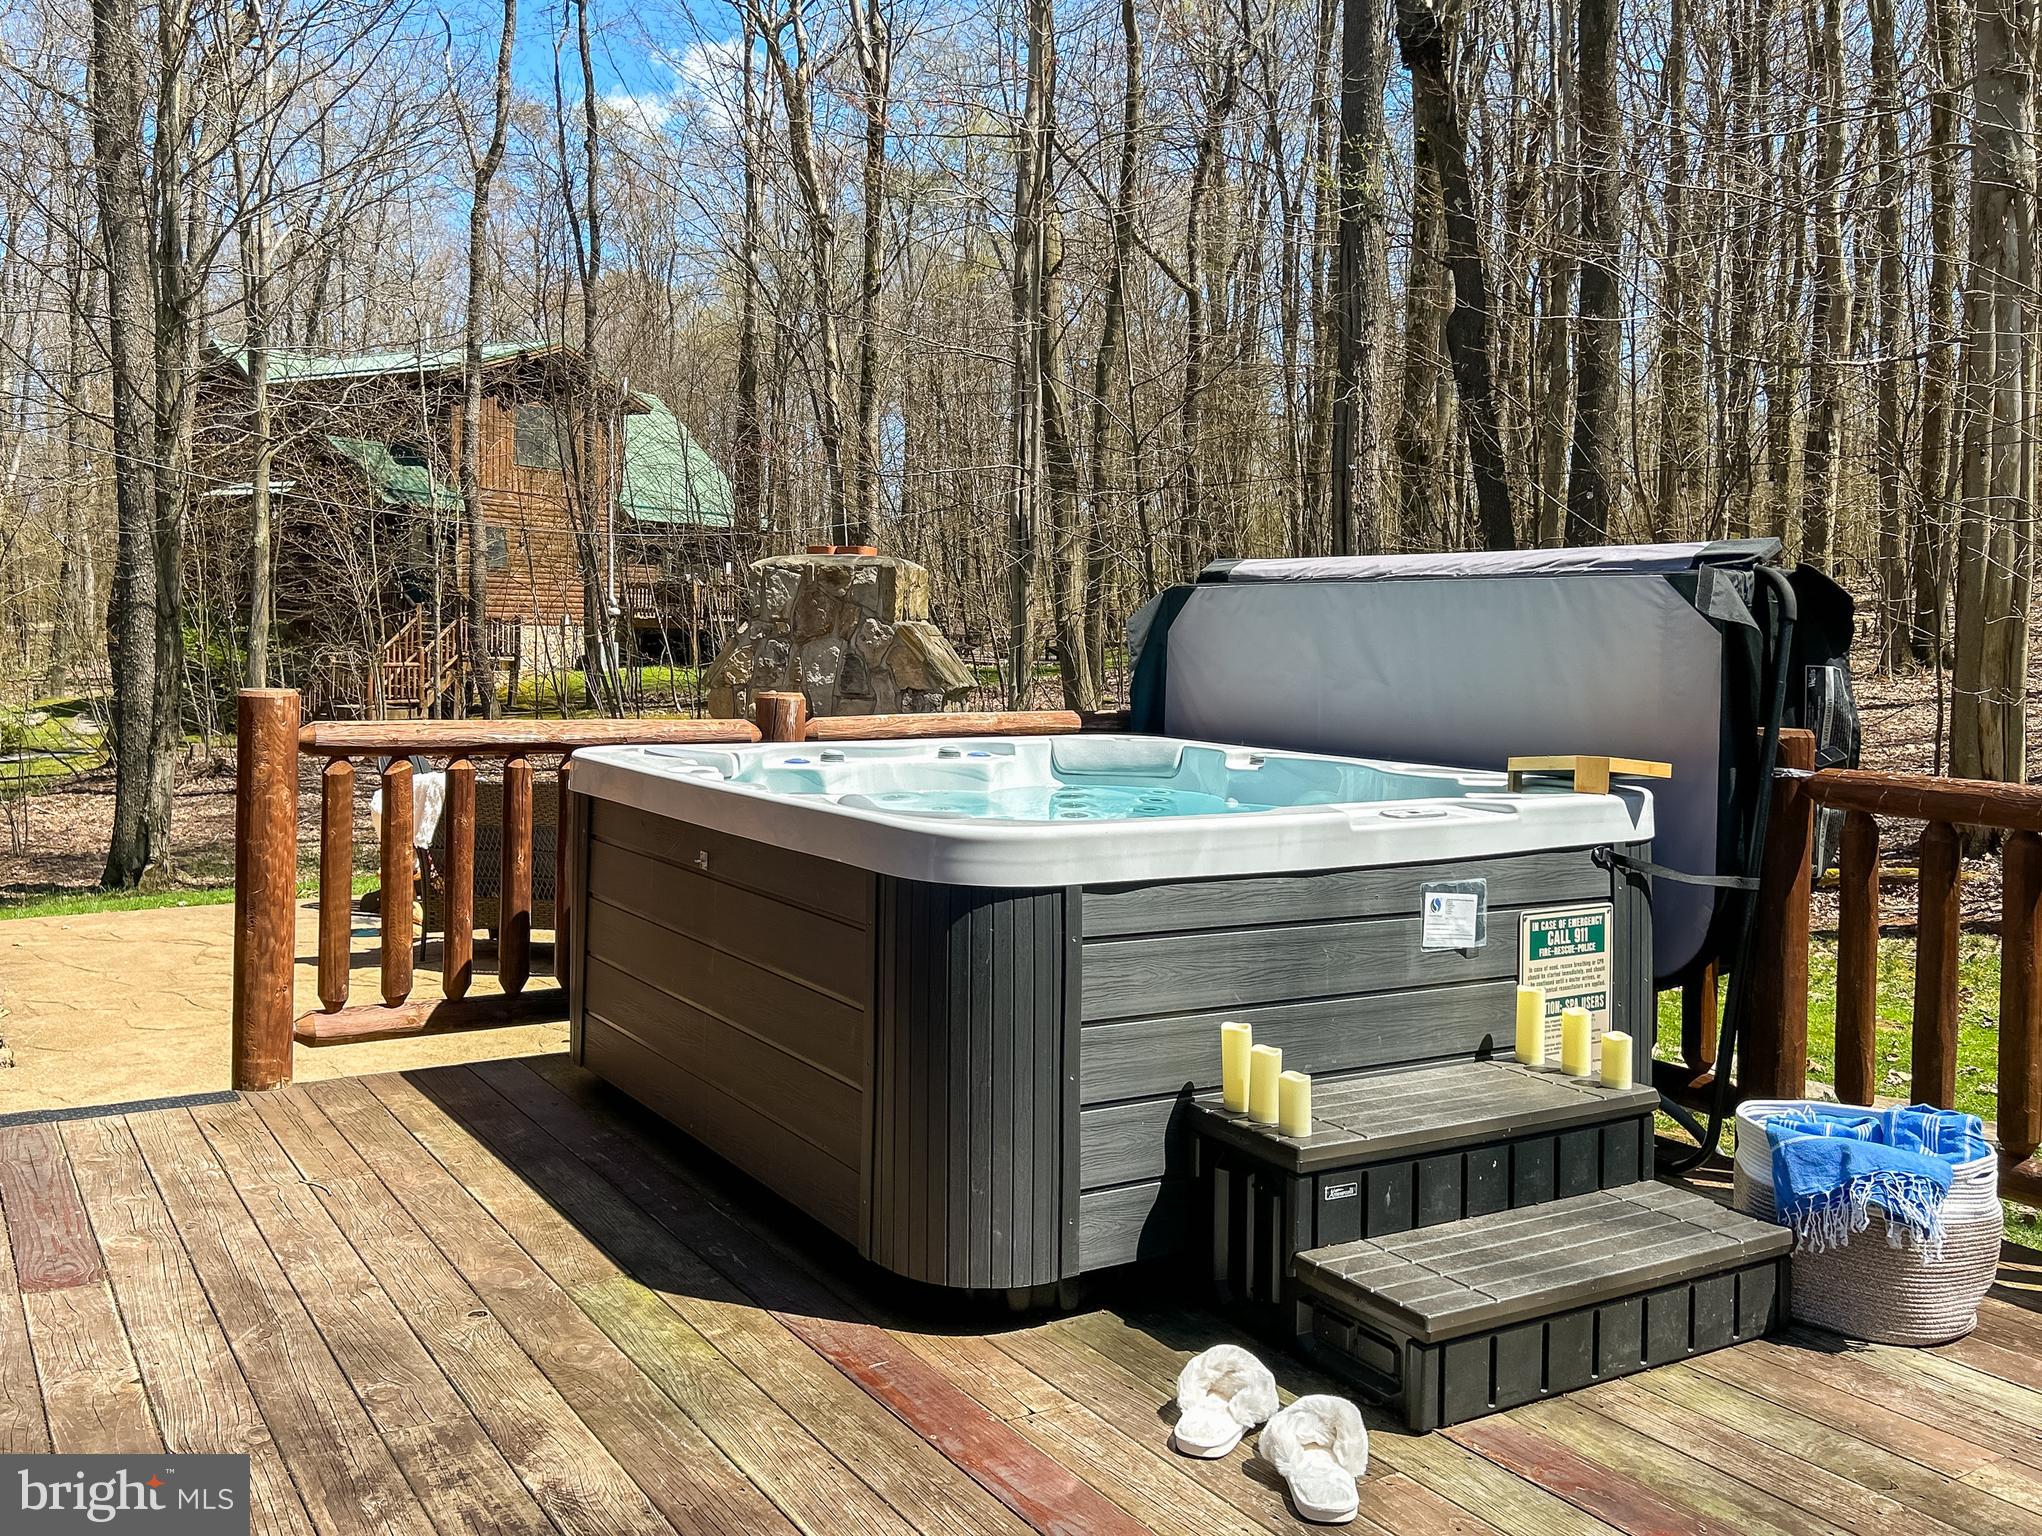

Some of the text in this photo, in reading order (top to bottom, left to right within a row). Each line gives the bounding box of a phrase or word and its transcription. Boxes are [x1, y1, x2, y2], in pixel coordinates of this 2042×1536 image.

[1532, 915, 1603, 931] IN CASE OF EMERGENCY
[1547, 927, 1589, 946] CALL 911
[1565, 997, 1579, 1009] SPA
[1581, 994, 1605, 1009] USERS
